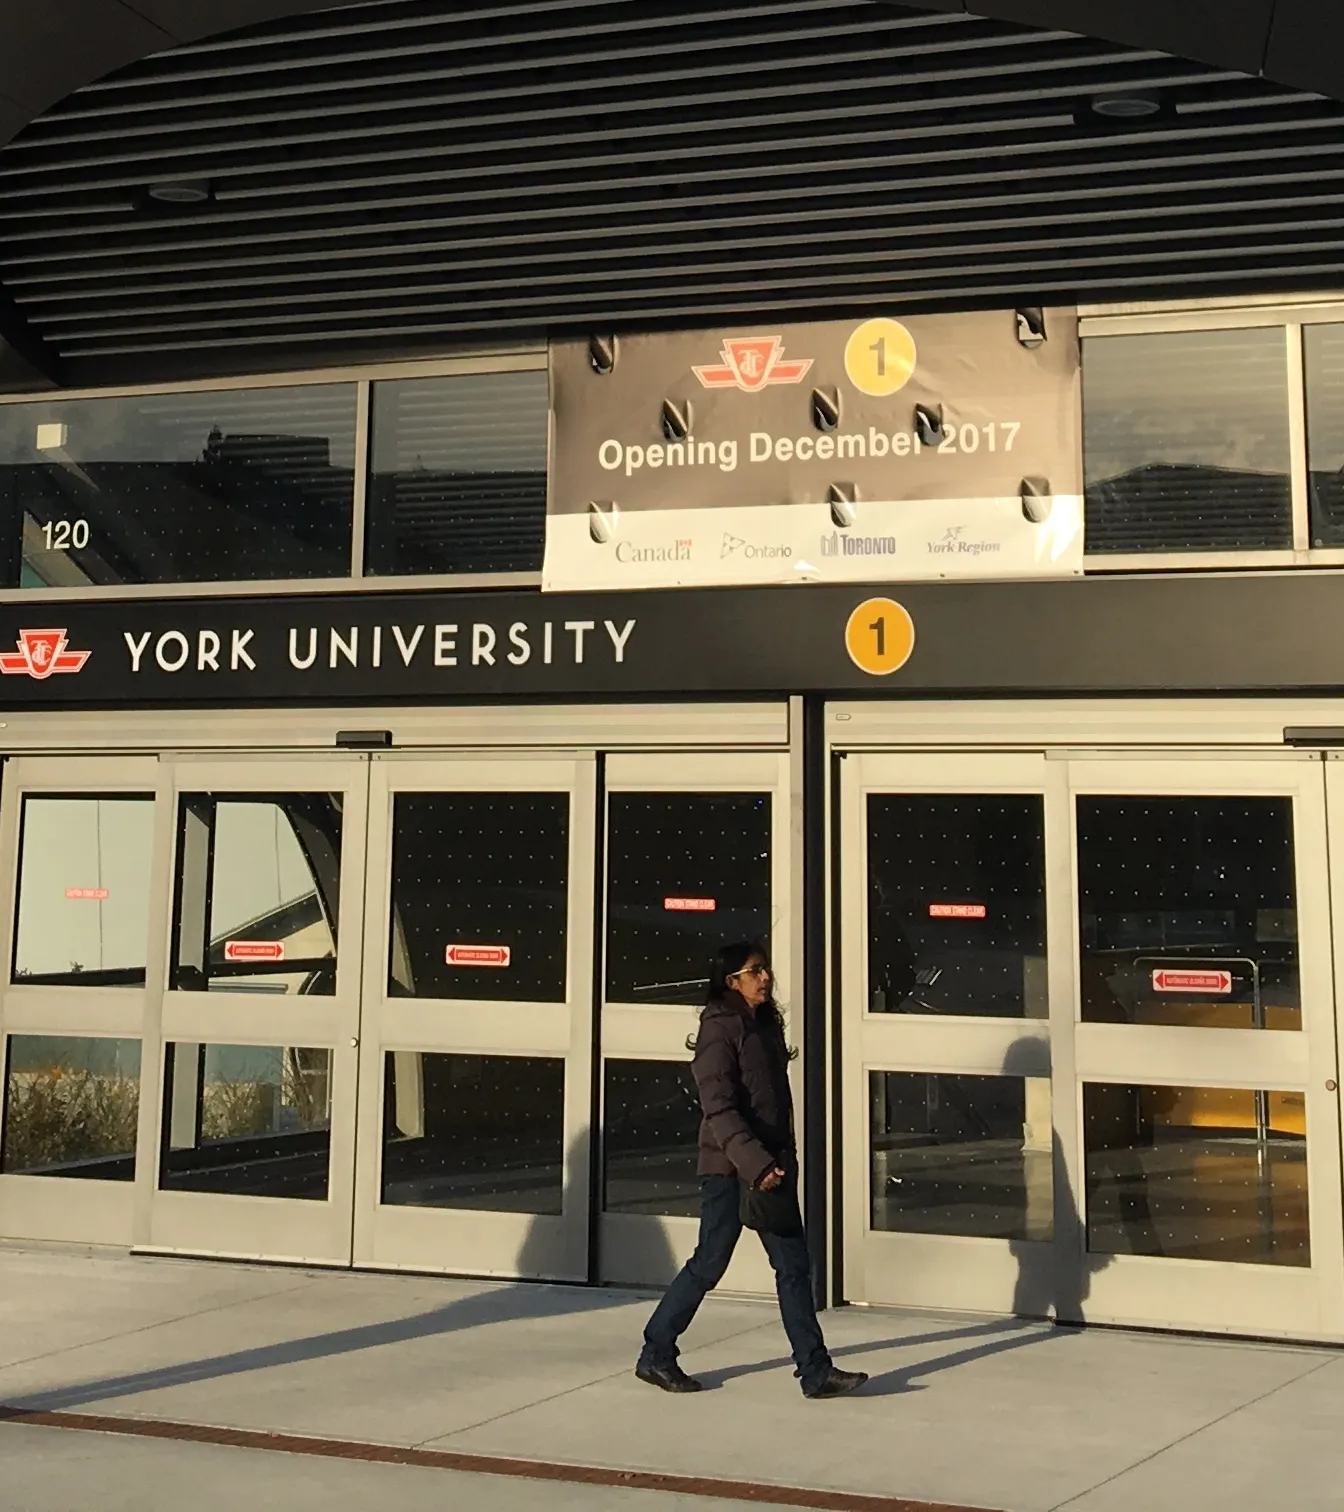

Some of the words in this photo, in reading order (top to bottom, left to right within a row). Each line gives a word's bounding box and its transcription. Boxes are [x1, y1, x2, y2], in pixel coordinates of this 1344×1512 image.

[868, 337, 886, 376] 1
[598, 435, 739, 477] Opening
[749, 426, 922, 462] December
[936, 421, 1022, 454] 2017
[41, 519, 90, 550] 120
[840, 533, 897, 556] TORONTO
[925, 540, 955, 555] York
[957, 539, 1002, 557] Region
[614, 539, 692, 563] Canada
[744, 544, 793, 559] Ontario
[123, 628, 257, 672] YORK
[288, 619, 637, 671] UNIVERSITY
[868, 616, 885, 656] 1
